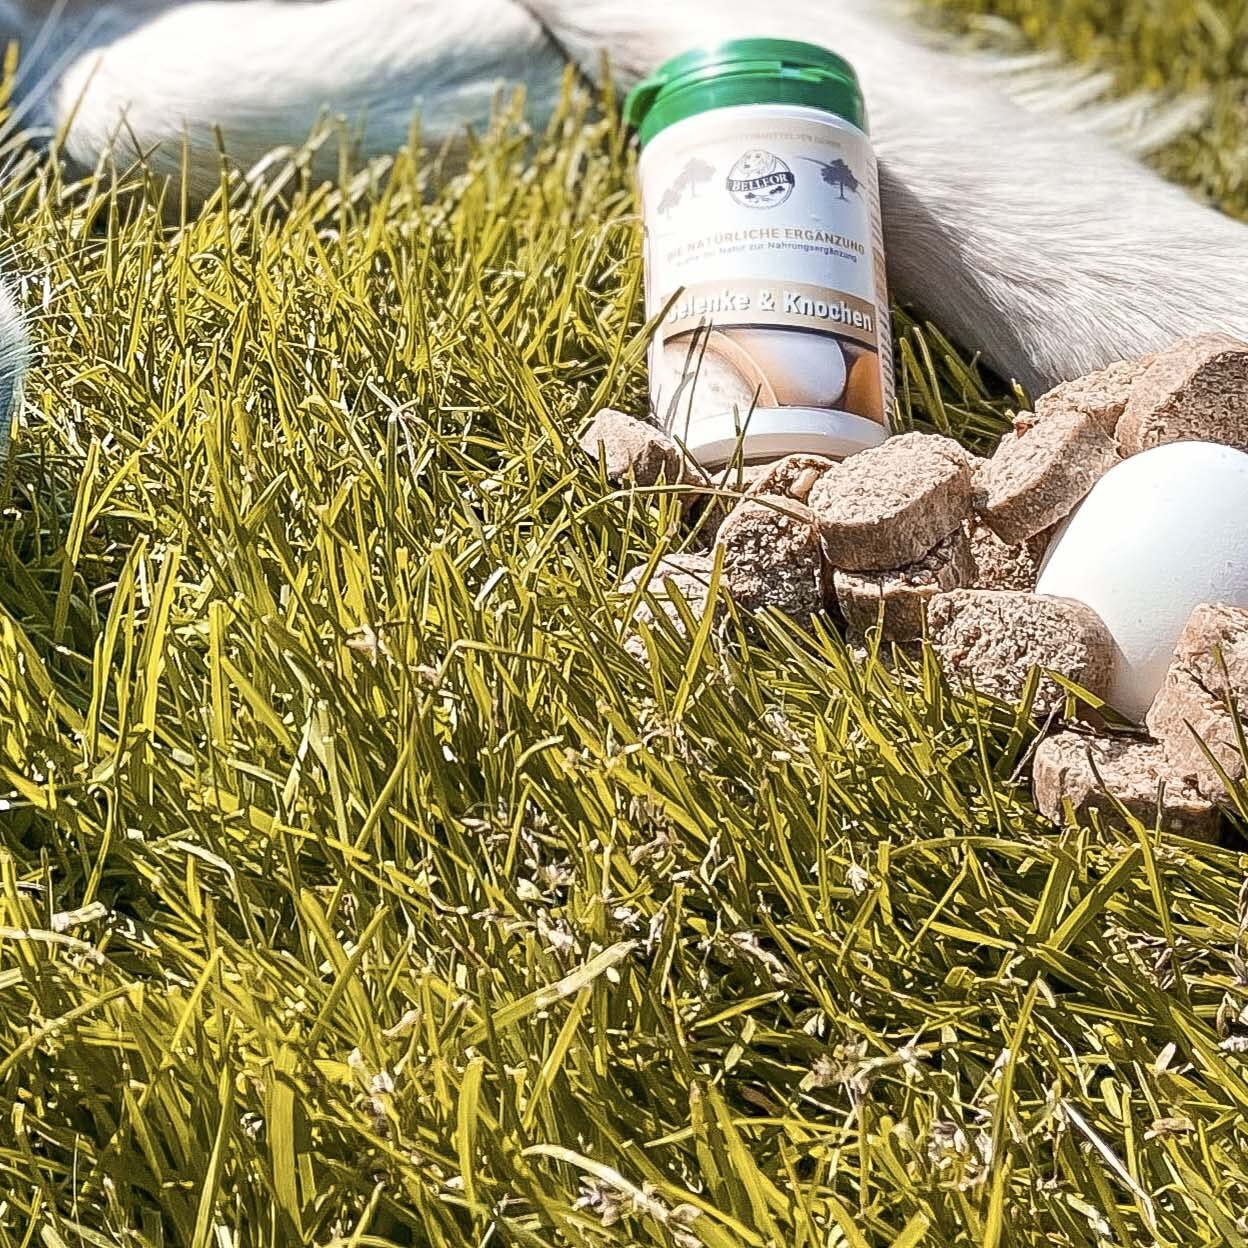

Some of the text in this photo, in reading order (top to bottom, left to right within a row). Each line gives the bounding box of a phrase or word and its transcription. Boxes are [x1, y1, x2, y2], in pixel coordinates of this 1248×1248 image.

[732, 174, 788, 191] BELLFOR
[687, 228, 779, 253] NATÜRLICHE
[758, 289, 776, 312] &
[784, 290, 873, 332] Knochen
